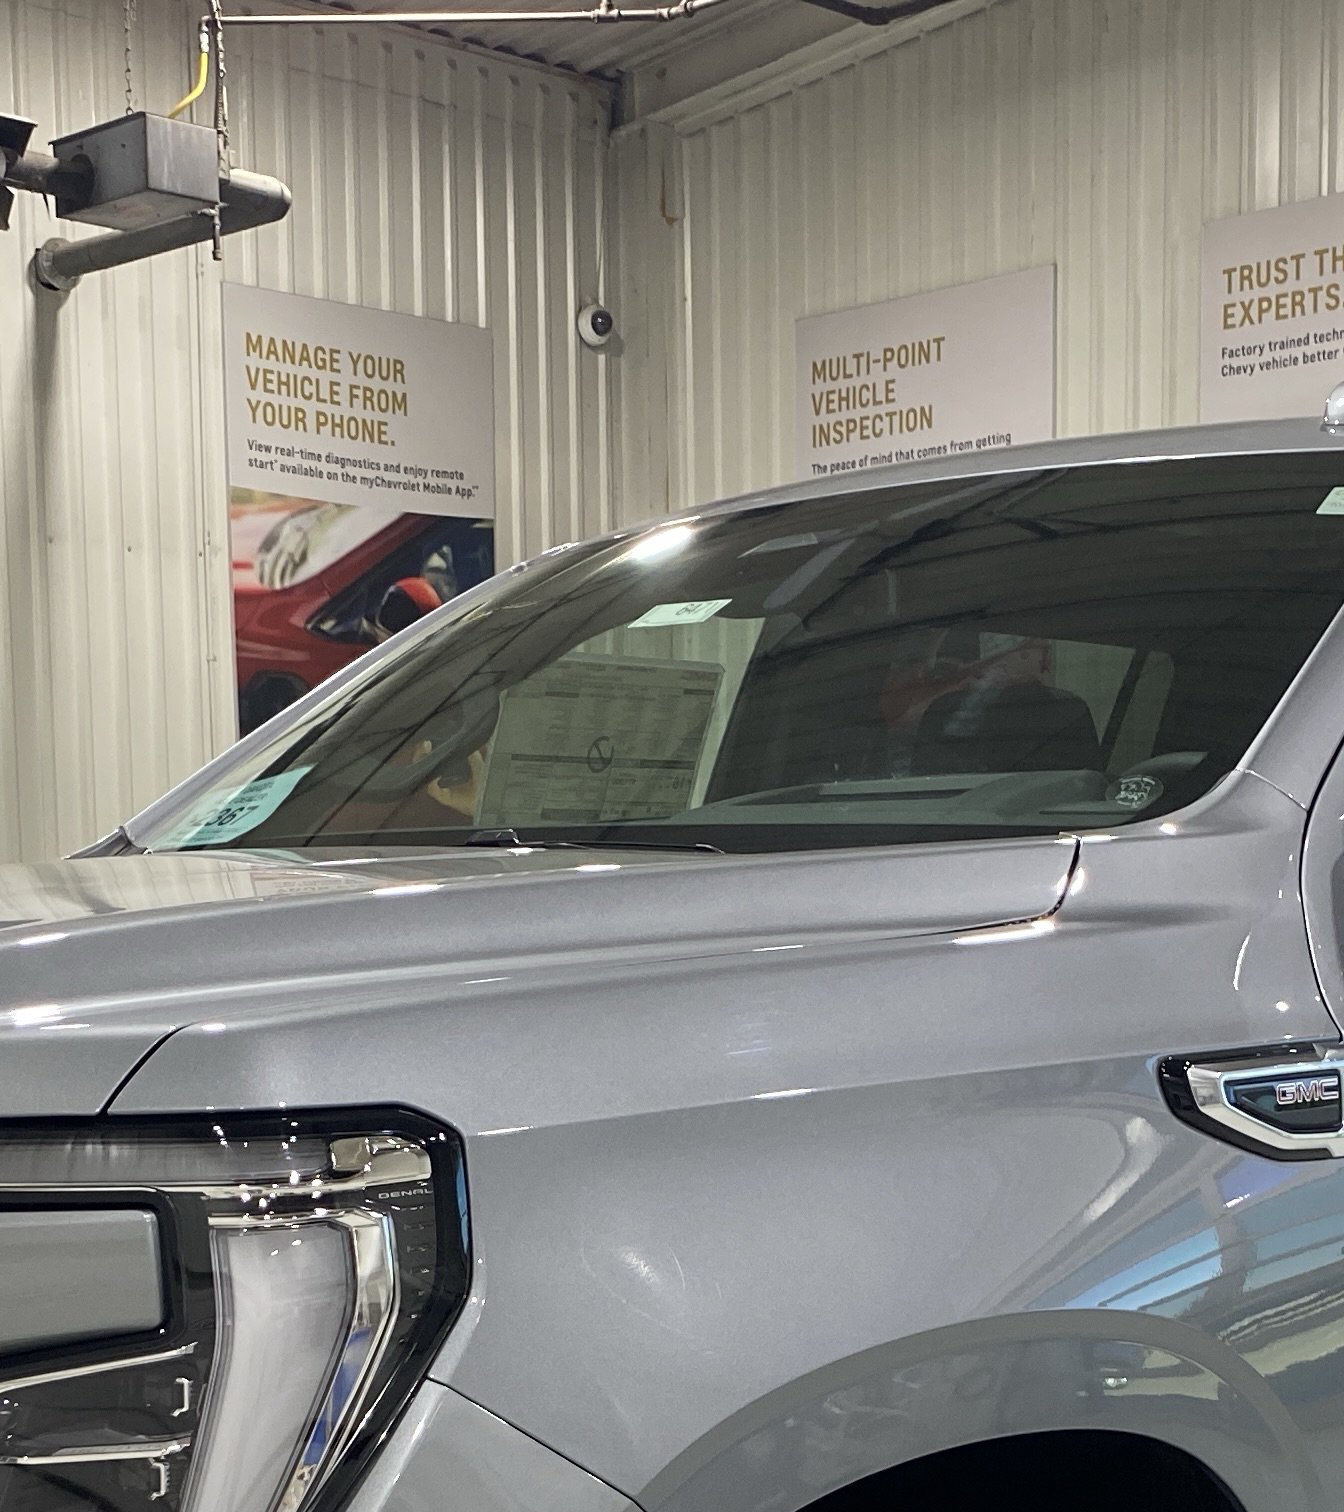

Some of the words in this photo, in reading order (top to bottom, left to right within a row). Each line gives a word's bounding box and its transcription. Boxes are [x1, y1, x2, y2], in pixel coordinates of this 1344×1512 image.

[1222, 252, 1306, 294] TRUST
[245, 331, 341, 374] MANAGE
[348, 351, 406, 385] YOUR
[811, 336, 946, 385] MULTI-POINT
[1221, 338, 1265, 360] Factory
[1268, 332, 1310, 351] trained
[1221, 360, 1256, 377] Chevy
[1259, 353, 1299, 372] vehicle
[1302, 347, 1339, 365] better
[245, 364, 341, 407] VEHICLE
[348, 384, 408, 417] FROM
[811, 378, 897, 417] VEHICLE
[247, 397, 308, 433] YOUR
[315, 411, 396, 447] PHONE.
[811, 404, 933, 449] INSPECTION
[246, 438, 272, 454] View
[275, 444, 323, 463] real-time
[325, 451, 381, 473] diagnostics
[383, 461, 401, 474] and
[403, 465, 429, 481] enjoy
[431, 469, 465, 482] remote
[811, 462, 828, 476] The
[830, 459, 856, 476] peace
[858, 454, 868, 469] of
[870, 450, 893, 466] mind
[895, 448, 915, 462] that
[917, 444, 948, 459] comes
[950, 437, 974, 453] from
[975, 432, 1011, 450] getting
[280, 461, 324, 481] available
[326, 471, 338, 482] on
[341, 471, 357, 485] the
[359, 474, 421, 494] myChevrolet
[423, 480, 453, 496] Mobile
[1276, 1074, 1340, 1106] GMC
[378, 1188, 434, 1200] DENAL
